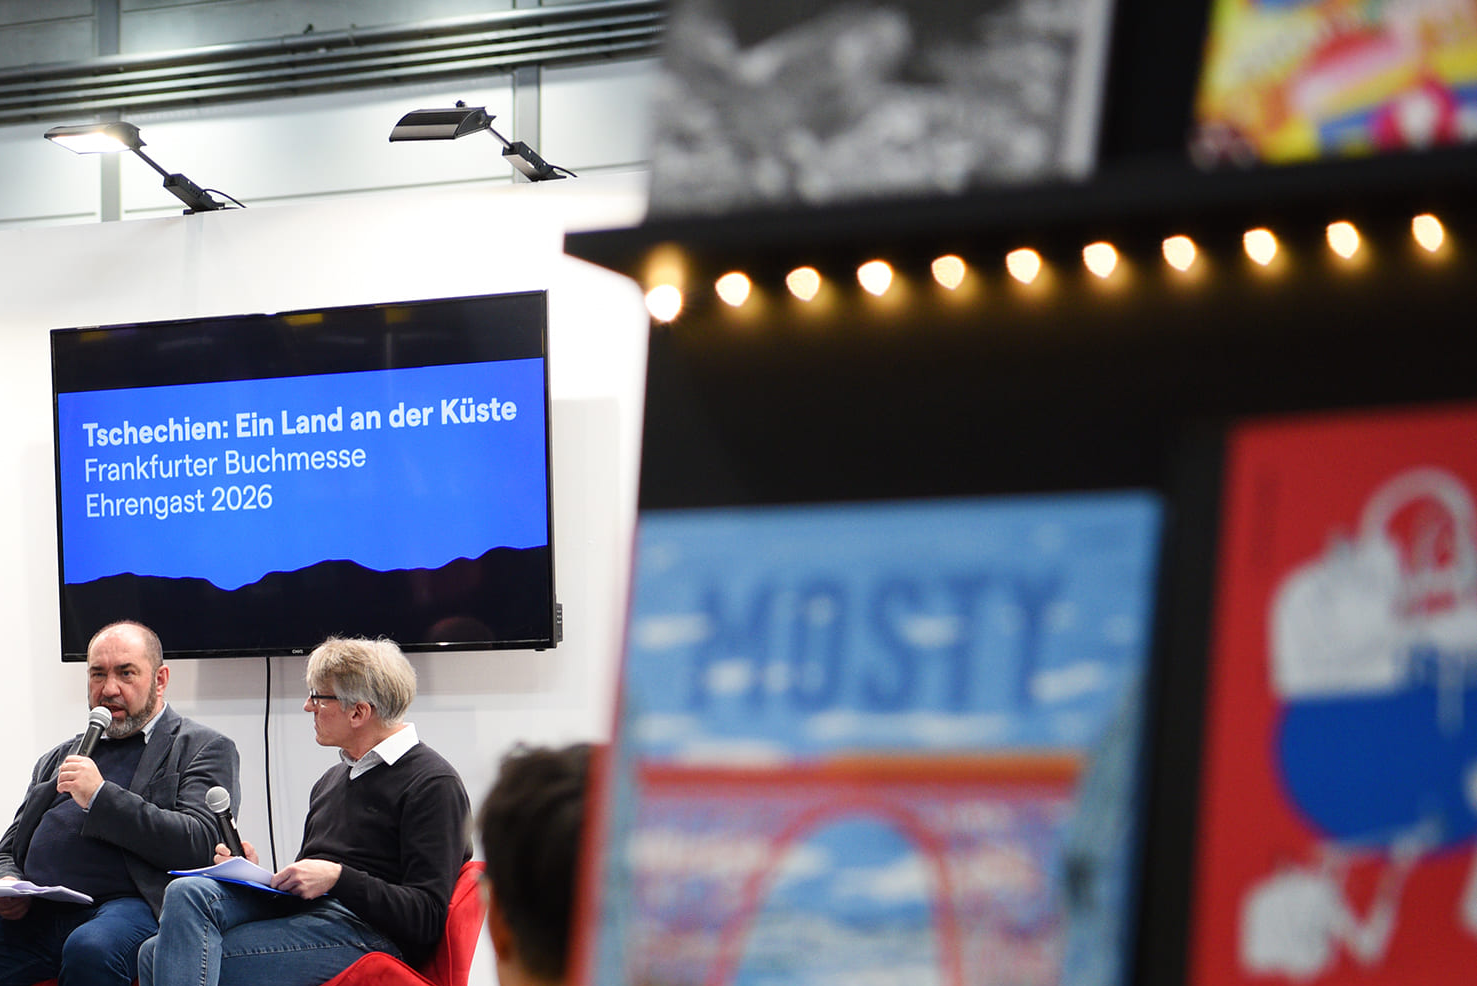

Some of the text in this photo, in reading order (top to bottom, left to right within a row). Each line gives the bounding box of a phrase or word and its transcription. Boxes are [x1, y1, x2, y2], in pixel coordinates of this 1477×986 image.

[83, 396, 517, 448] Tschechien: Ein Land an der Küste
[84, 445, 366, 484] Frankfurter Buchmesse
[86, 484, 273, 520] Ehrengast 2026
